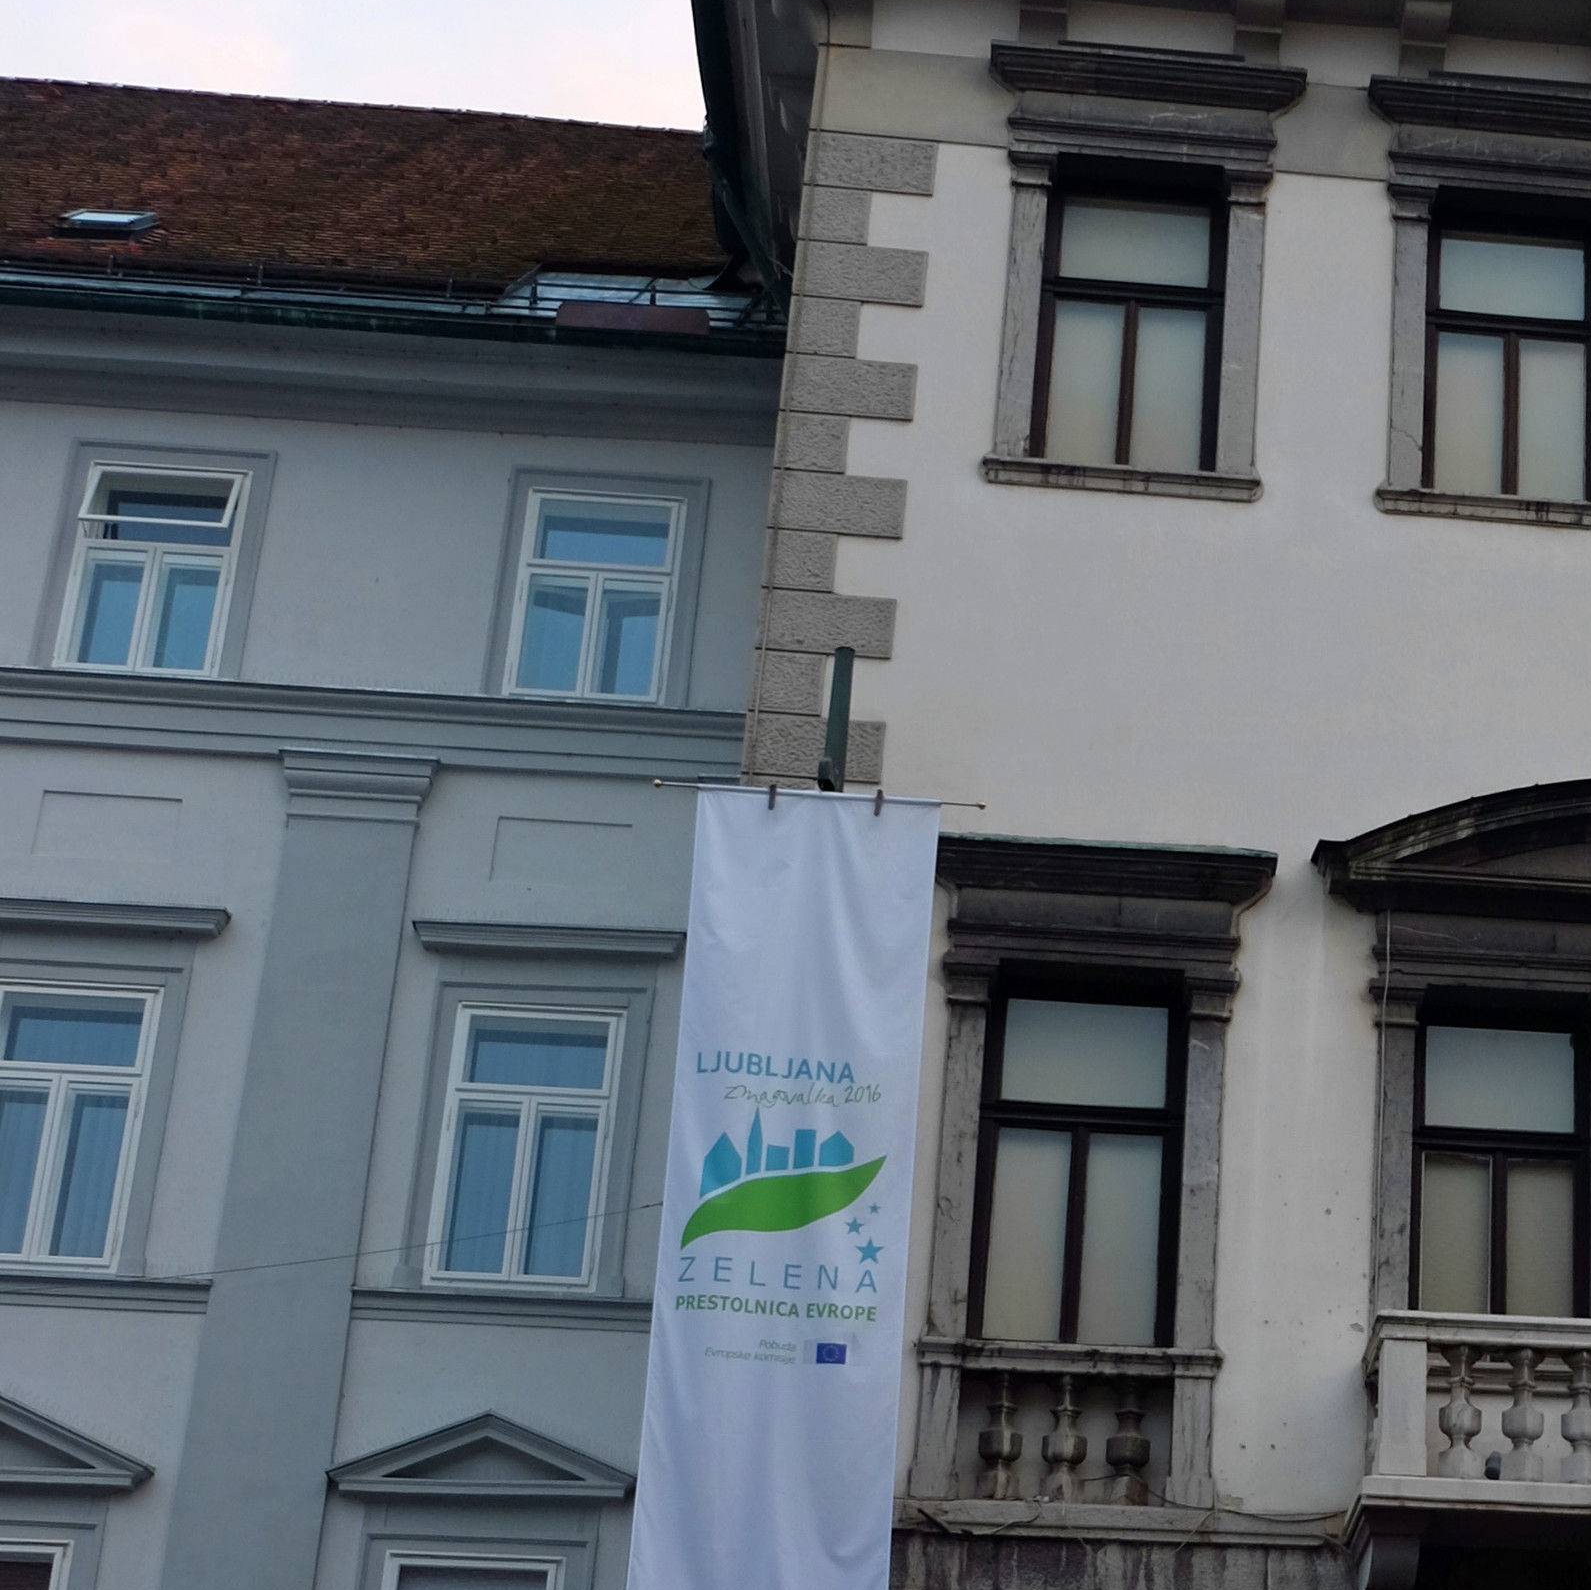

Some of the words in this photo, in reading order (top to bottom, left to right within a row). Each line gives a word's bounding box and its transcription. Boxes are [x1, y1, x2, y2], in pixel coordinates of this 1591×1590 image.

[696, 1050, 856, 1084] LJUBLJANA
[844, 1084, 881, 1105] 2016
[678, 1256, 877, 1294] ZELENA
[675, 1294, 799, 1318] PRESTOLNICA
[805, 1302, 877, 1322] EVROPE
